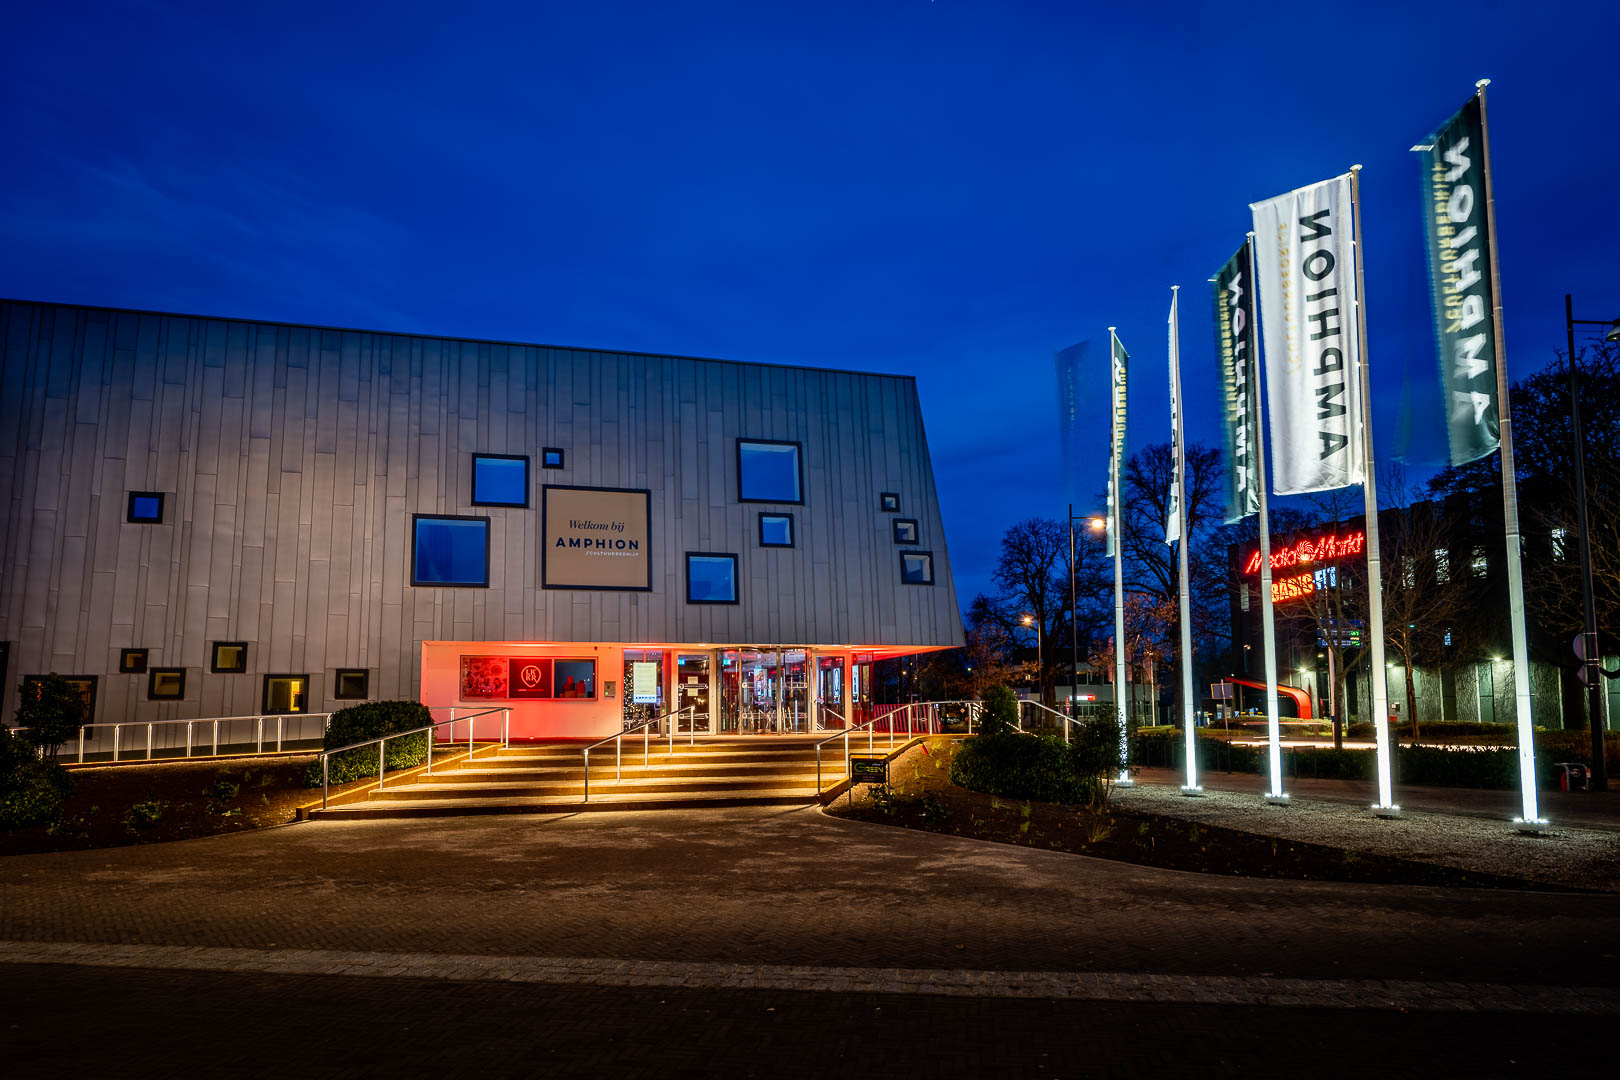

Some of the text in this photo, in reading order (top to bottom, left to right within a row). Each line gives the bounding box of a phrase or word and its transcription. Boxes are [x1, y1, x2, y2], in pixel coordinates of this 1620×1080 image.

[569, 520, 625, 533] Welkom bij
[555, 537, 639, 550] AMPHION
[1311, 532, 1364, 561] Markt
